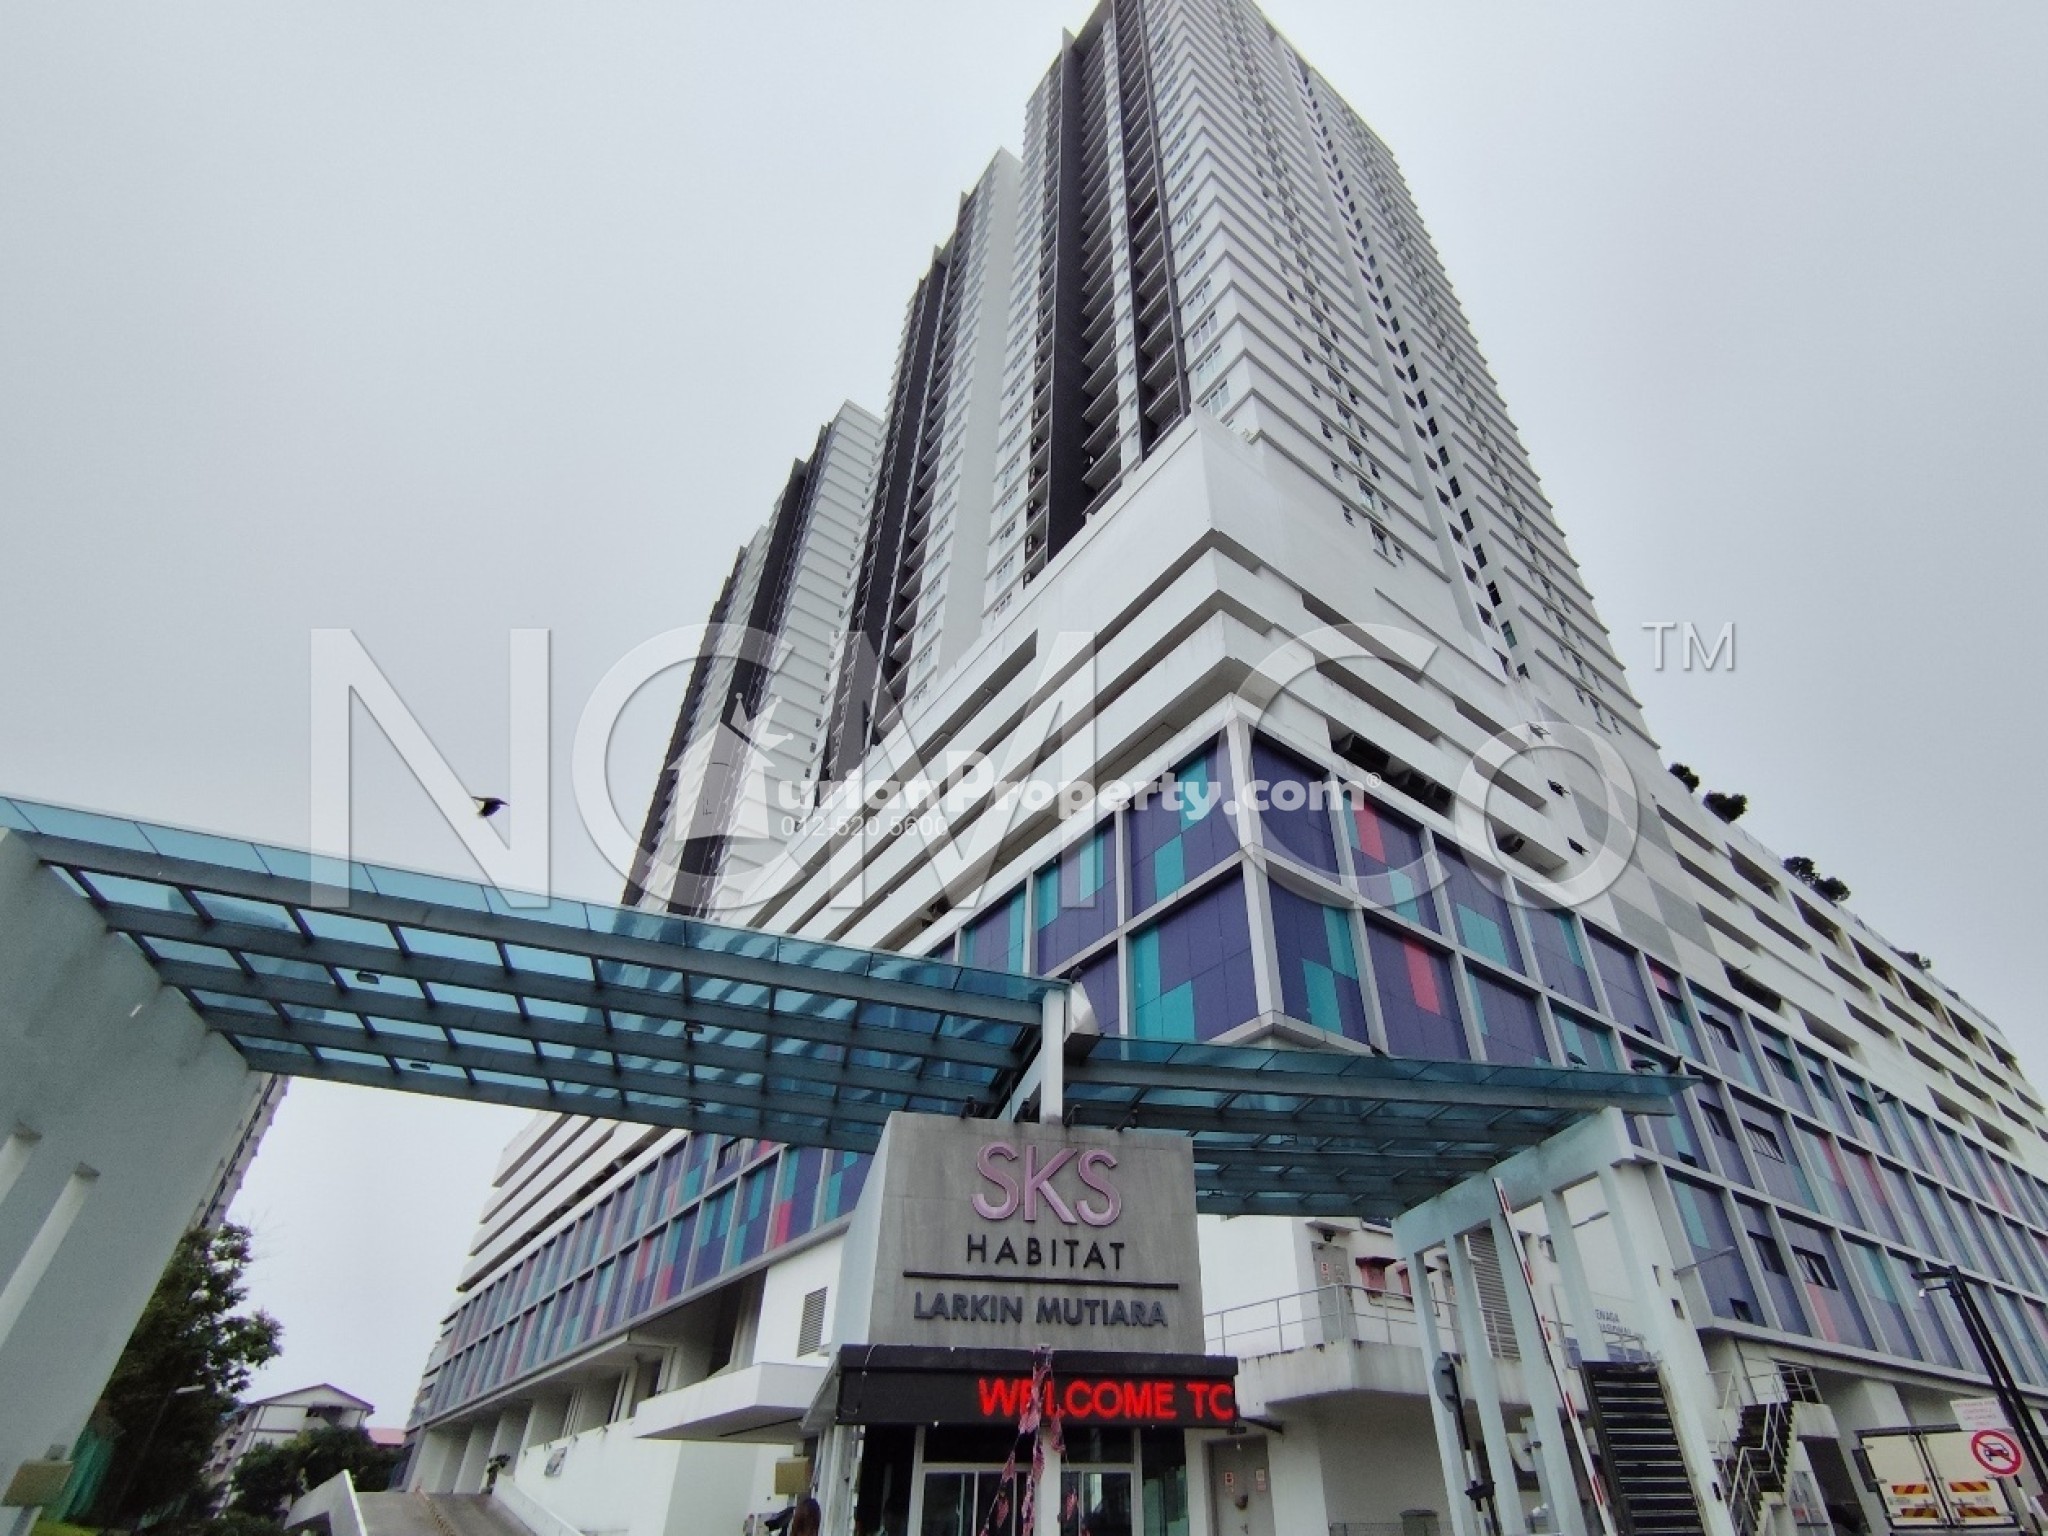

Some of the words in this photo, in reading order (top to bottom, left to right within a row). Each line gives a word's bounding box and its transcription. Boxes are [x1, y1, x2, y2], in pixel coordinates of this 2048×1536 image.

[971, 1141, 1122, 1227] SKS
[967, 1233, 1125, 1270] HABITAT
[914, 1291, 1023, 1325] LARKIN
[1036, 1295, 1168, 1328] MUTIARA
